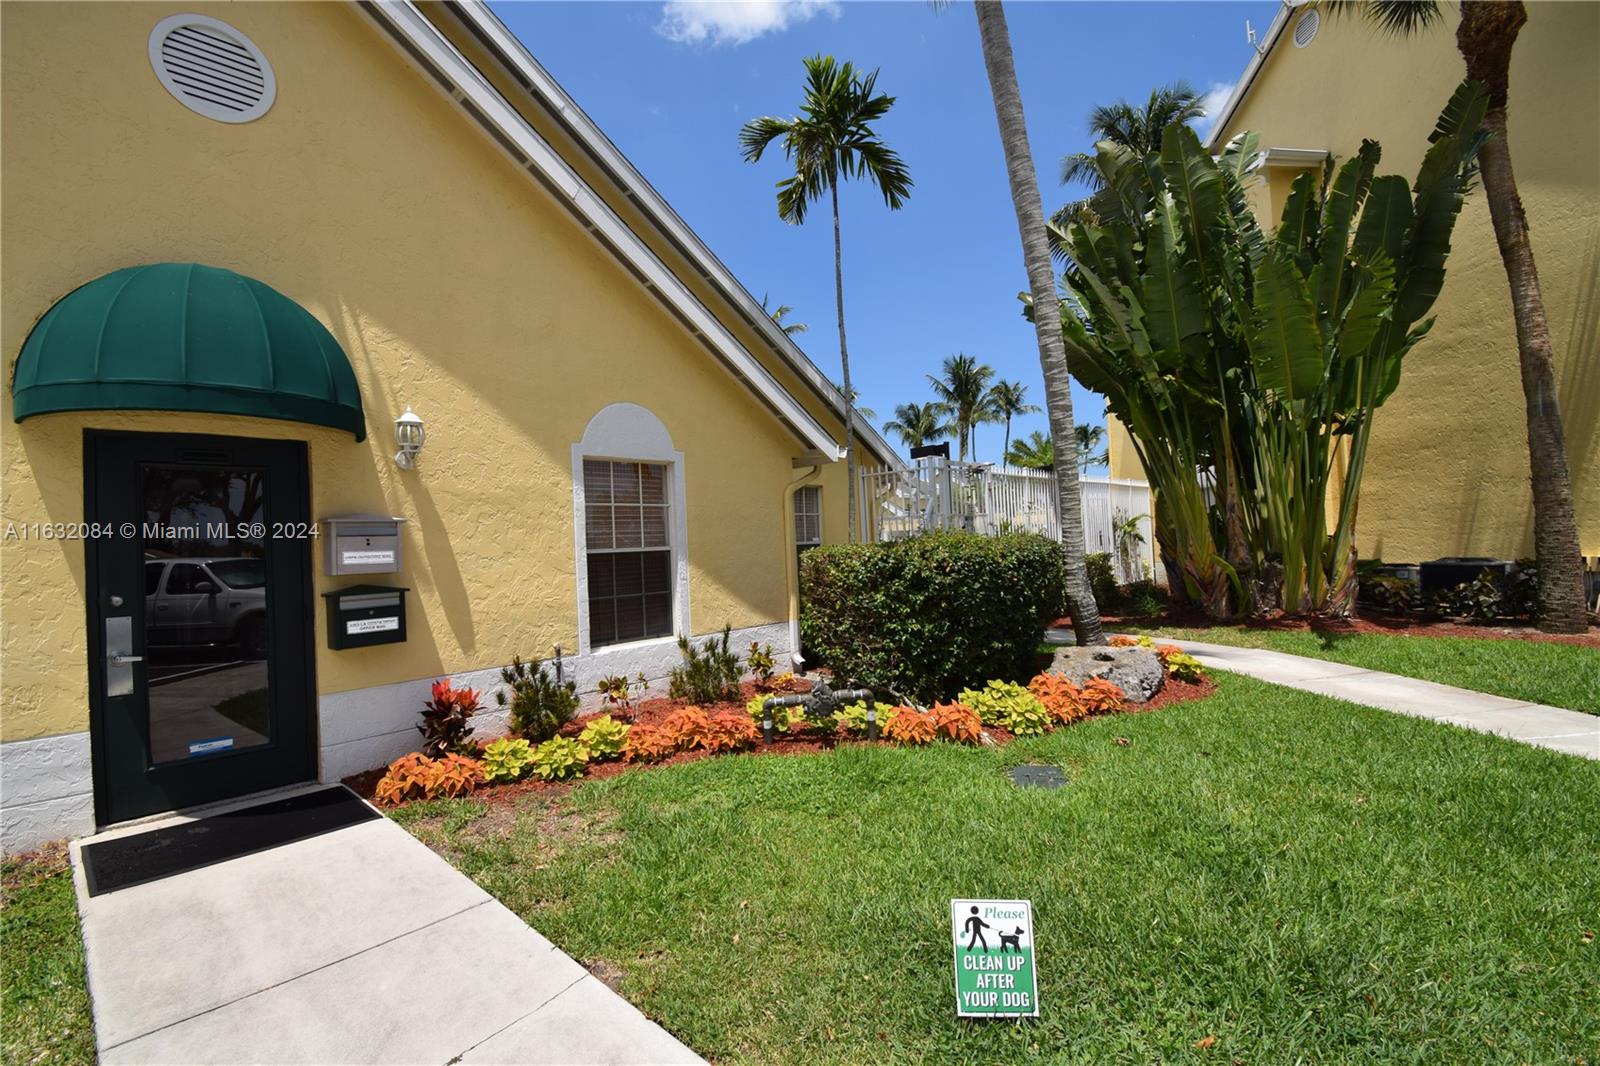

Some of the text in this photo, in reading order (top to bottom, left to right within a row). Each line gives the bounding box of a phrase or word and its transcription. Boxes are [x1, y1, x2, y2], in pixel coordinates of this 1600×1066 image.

[984, 907, 1025, 919] Please
[963, 955, 1025, 971] CLEAN UP
[976, 973, 1015, 989] AFTER
[963, 991, 1030, 1007] YOUR DOG
